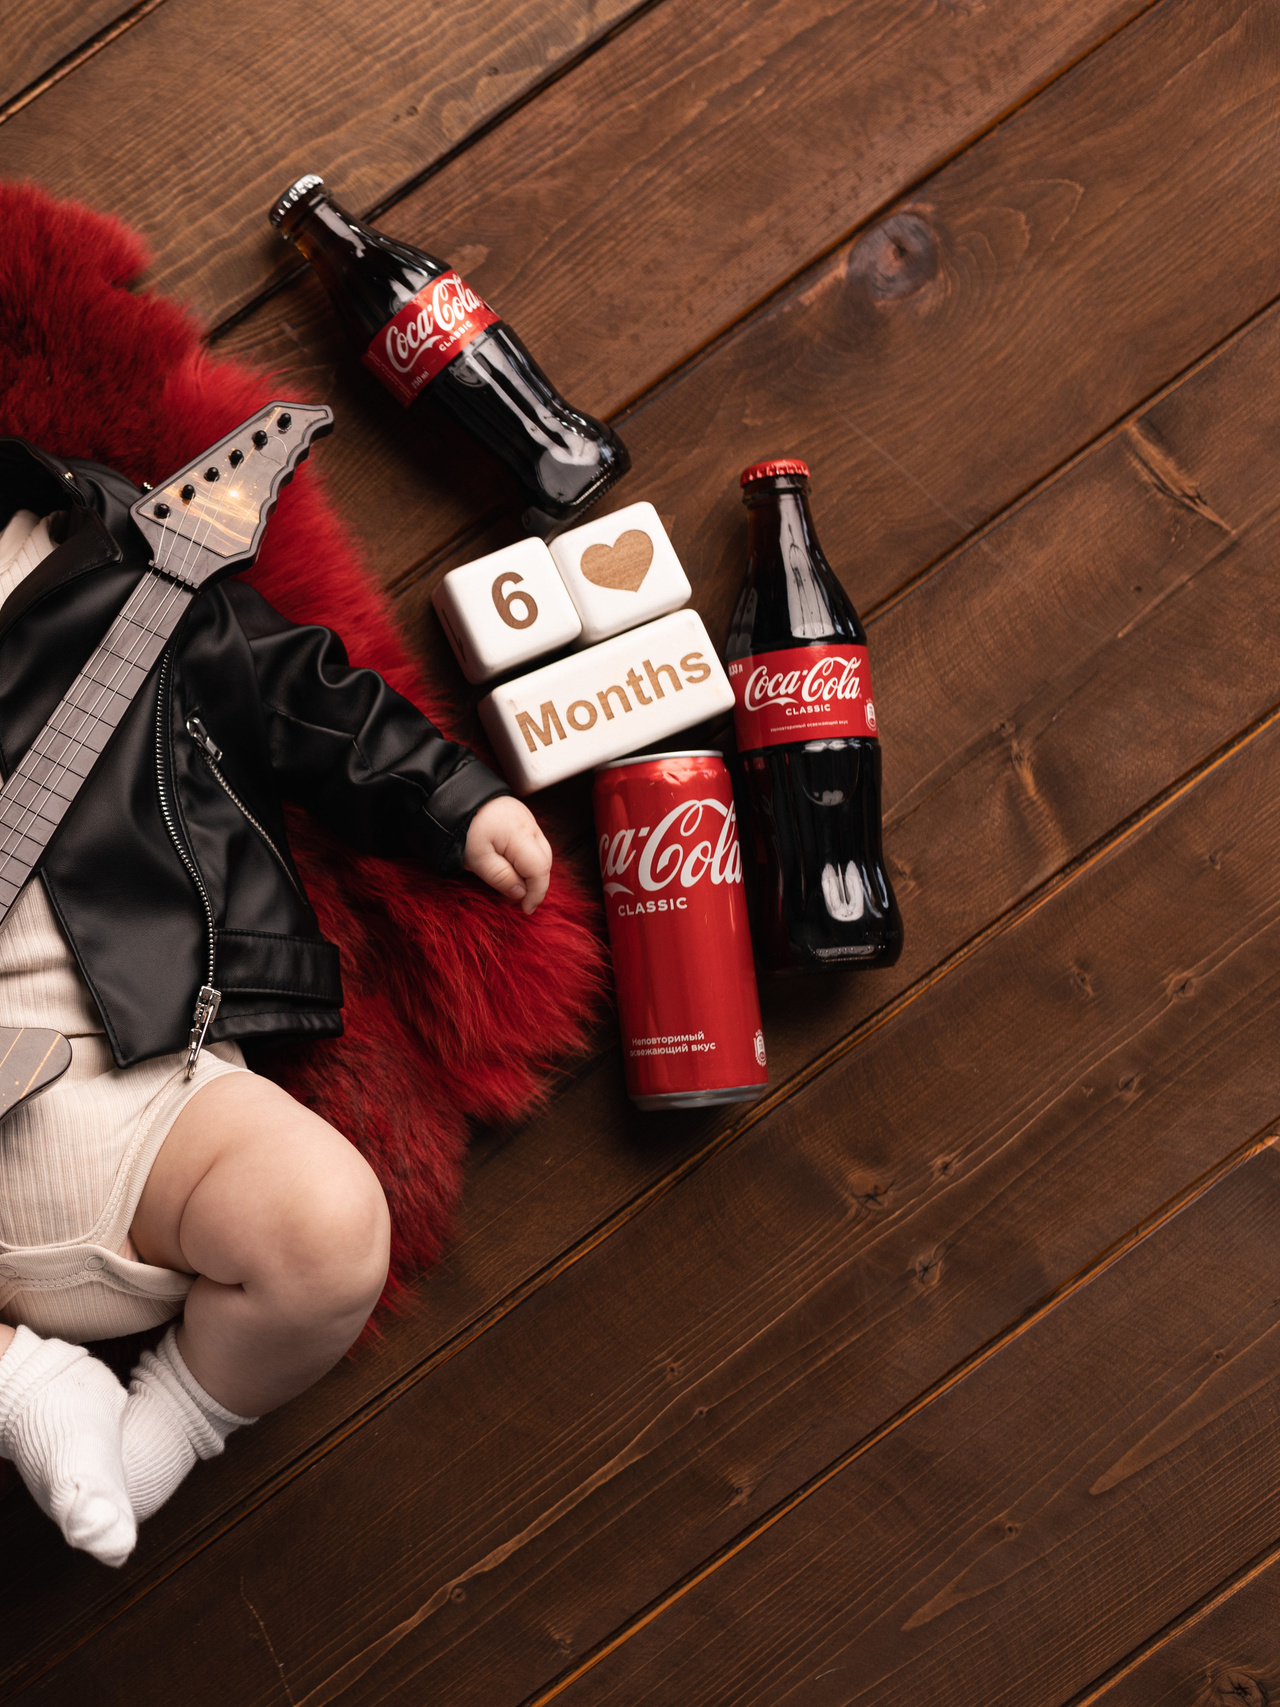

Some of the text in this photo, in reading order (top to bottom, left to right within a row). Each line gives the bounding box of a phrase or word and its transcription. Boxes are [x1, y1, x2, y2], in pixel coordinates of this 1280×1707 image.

[385, 273, 479, 373] Coca-Cola
[438, 319, 473, 352] CLASSIC
[491, 571, 538, 630] 6
[744, 656, 861, 712] Coca-Cola
[515, 652, 711, 752] Months
[785, 703, 831, 716] CLASSIC
[618, 897, 688, 917] CLASSIC
[629, 1041, 716, 1057] освежающий вкус
[631, 1031, 705, 1047] Неповторимый
